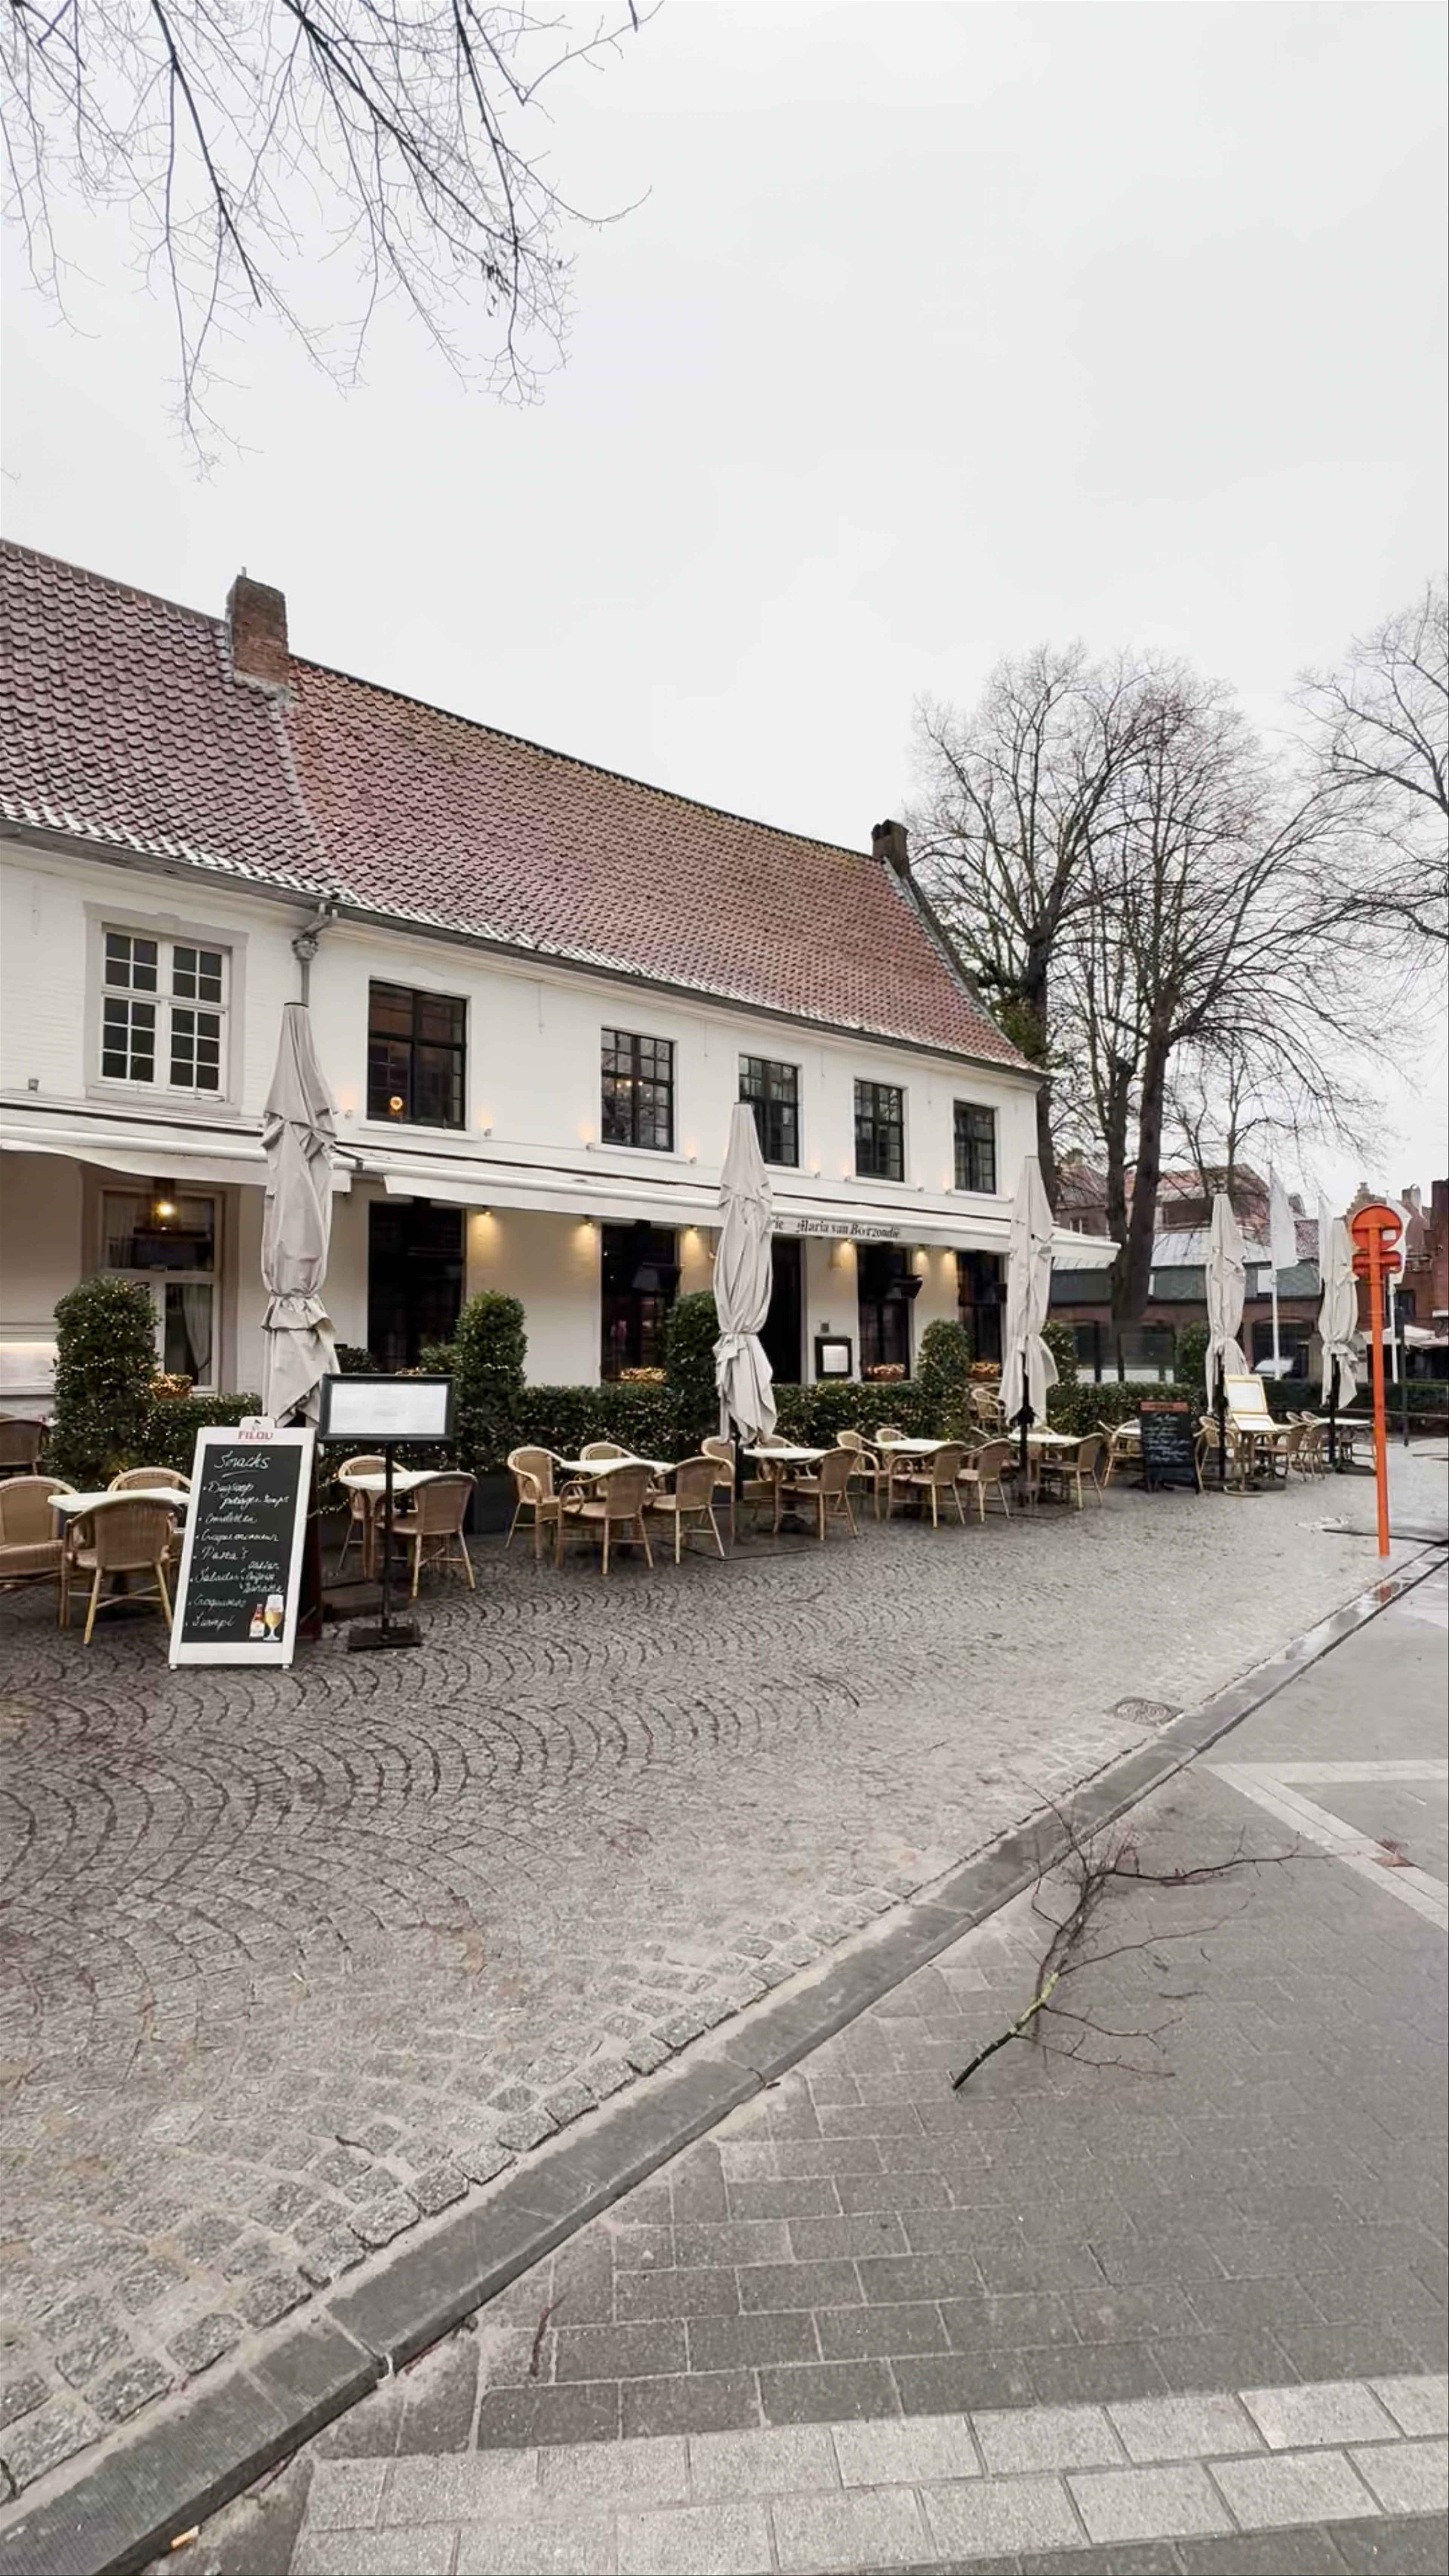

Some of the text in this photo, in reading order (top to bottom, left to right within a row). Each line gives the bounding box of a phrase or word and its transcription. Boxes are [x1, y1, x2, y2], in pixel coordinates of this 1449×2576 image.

[796, 1219, 829, 1233] Maria
[831, 1224, 849, 1234] van
[238, 1431, 274, 1440] FILOU
[214, 1450, 271, 1469] Snacks
